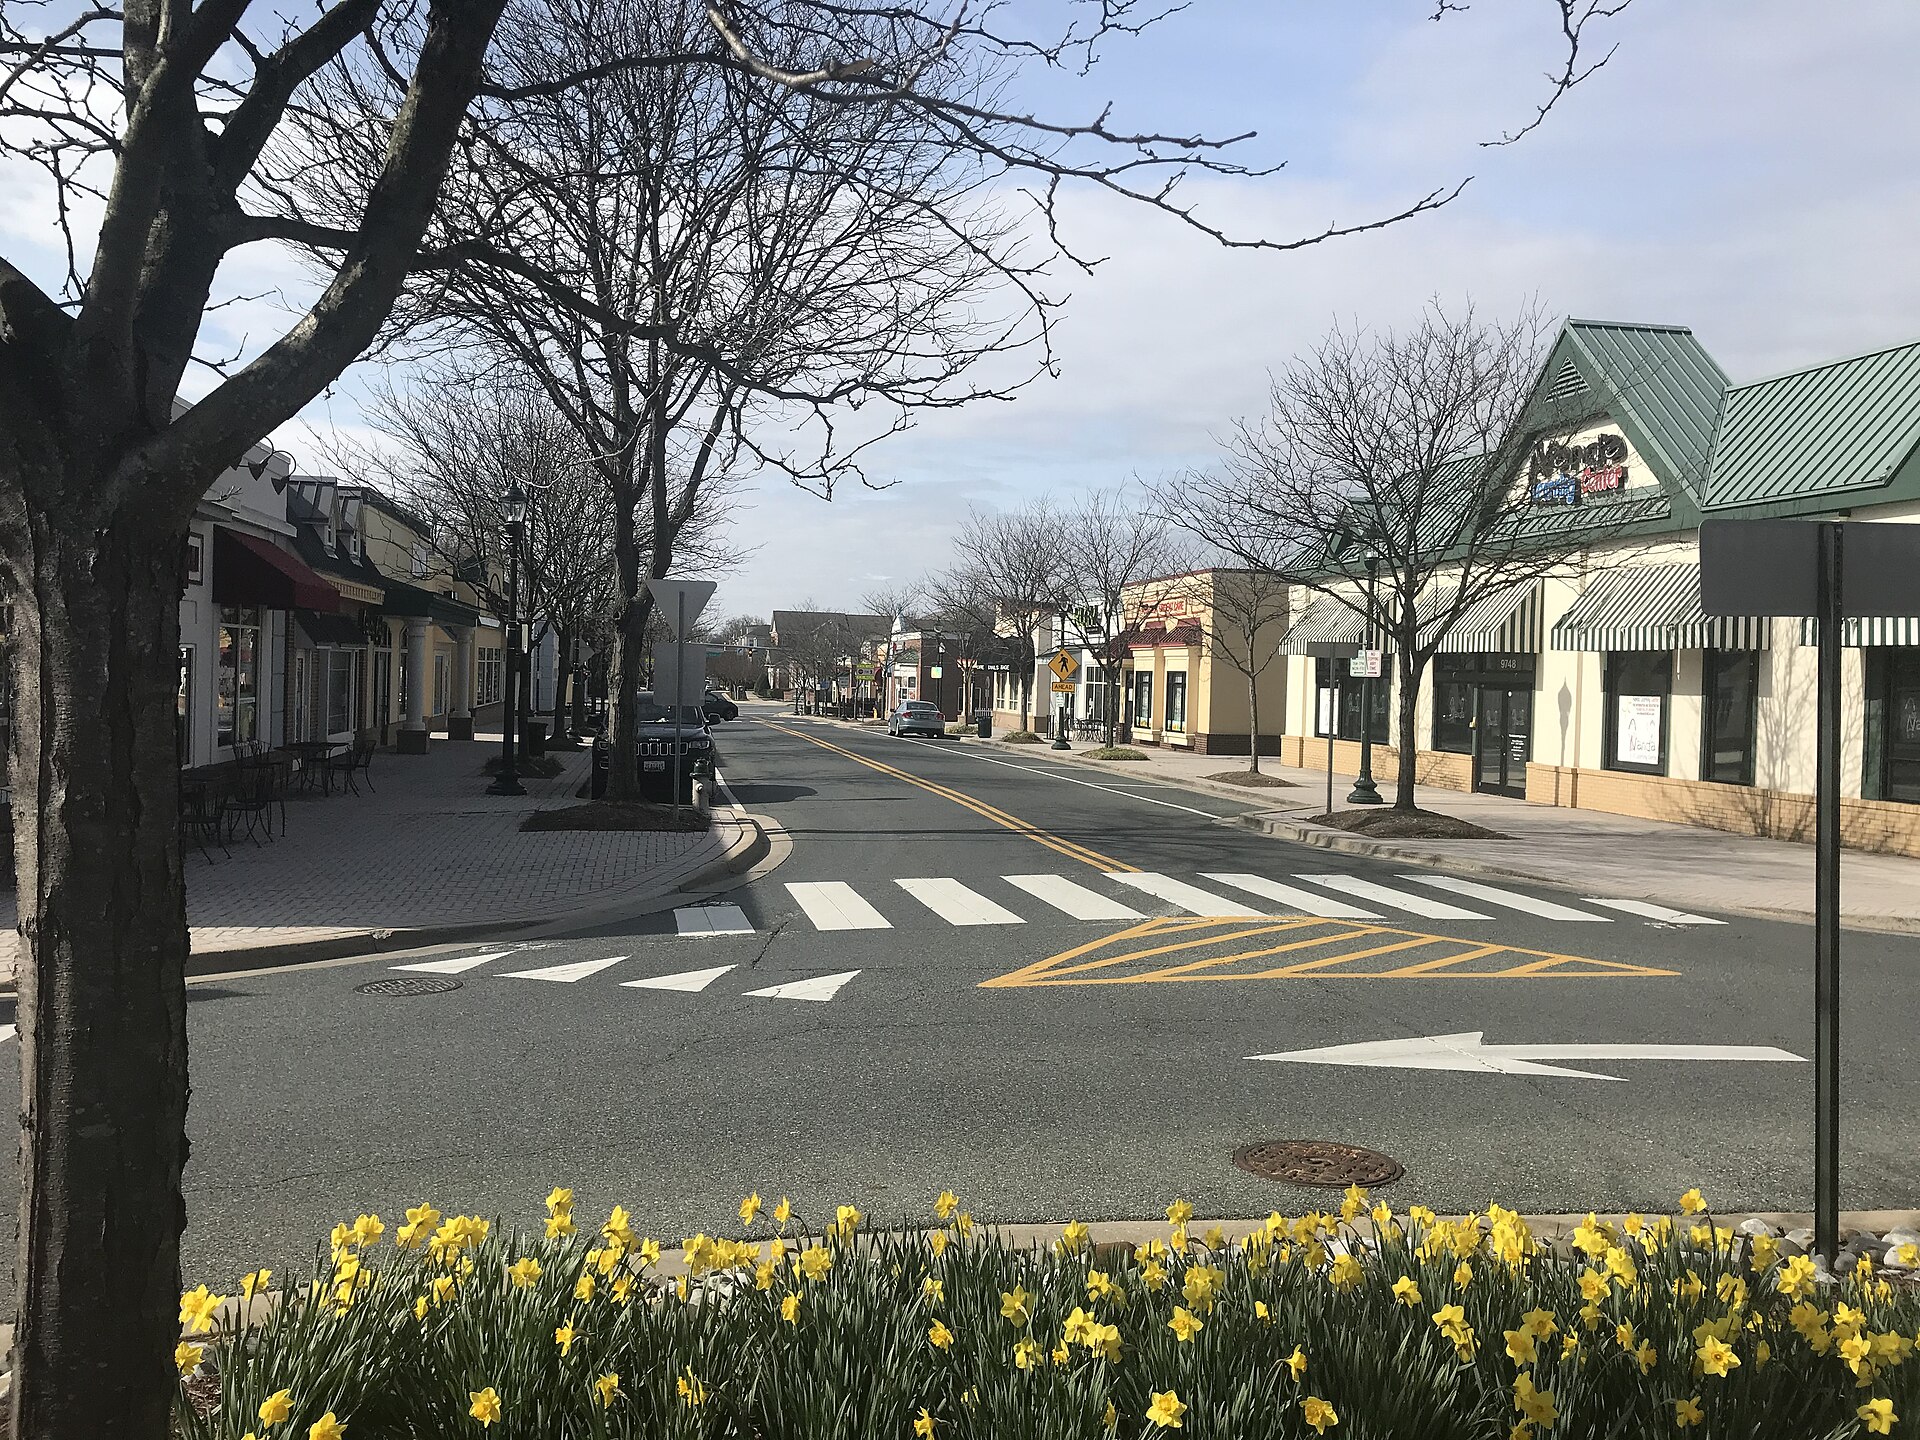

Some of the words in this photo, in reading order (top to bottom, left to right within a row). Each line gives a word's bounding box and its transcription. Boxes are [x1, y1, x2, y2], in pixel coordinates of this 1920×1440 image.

[1500, 659, 1517, 669] 9748
[1054, 683, 1073, 691] AHEAD
[1629, 736, 1656, 752] Nanda
